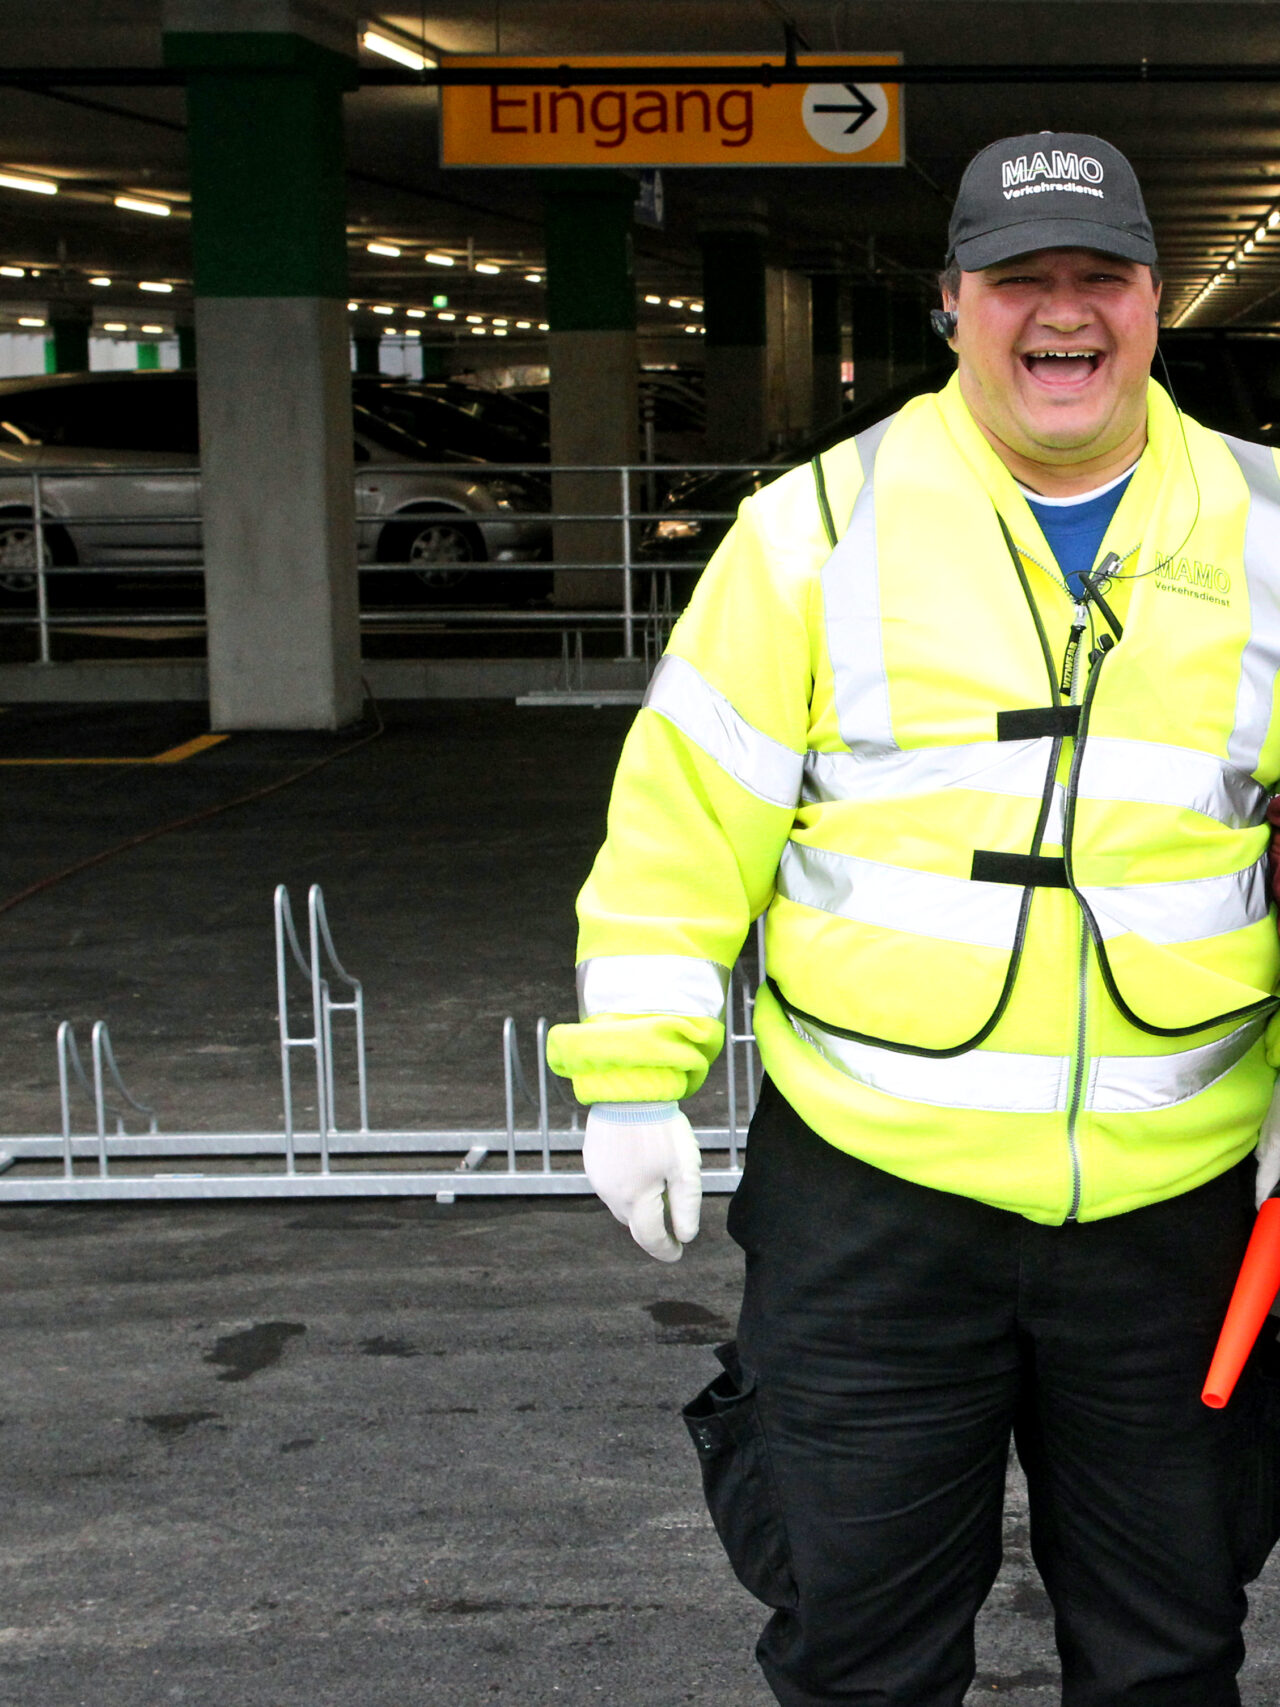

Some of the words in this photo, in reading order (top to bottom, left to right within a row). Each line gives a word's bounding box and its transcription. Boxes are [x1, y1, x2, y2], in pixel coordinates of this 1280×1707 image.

[490, 84, 754, 148] Eingang
[1002, 150, 1104, 188] MAMO
[1002, 182, 1104, 200] Verkehrsdienst
[1155, 551, 1231, 594] MAMO
[1155, 580, 1230, 608] Verkehrsdienst
[1063, 641, 1078, 689] VIZWEAR
